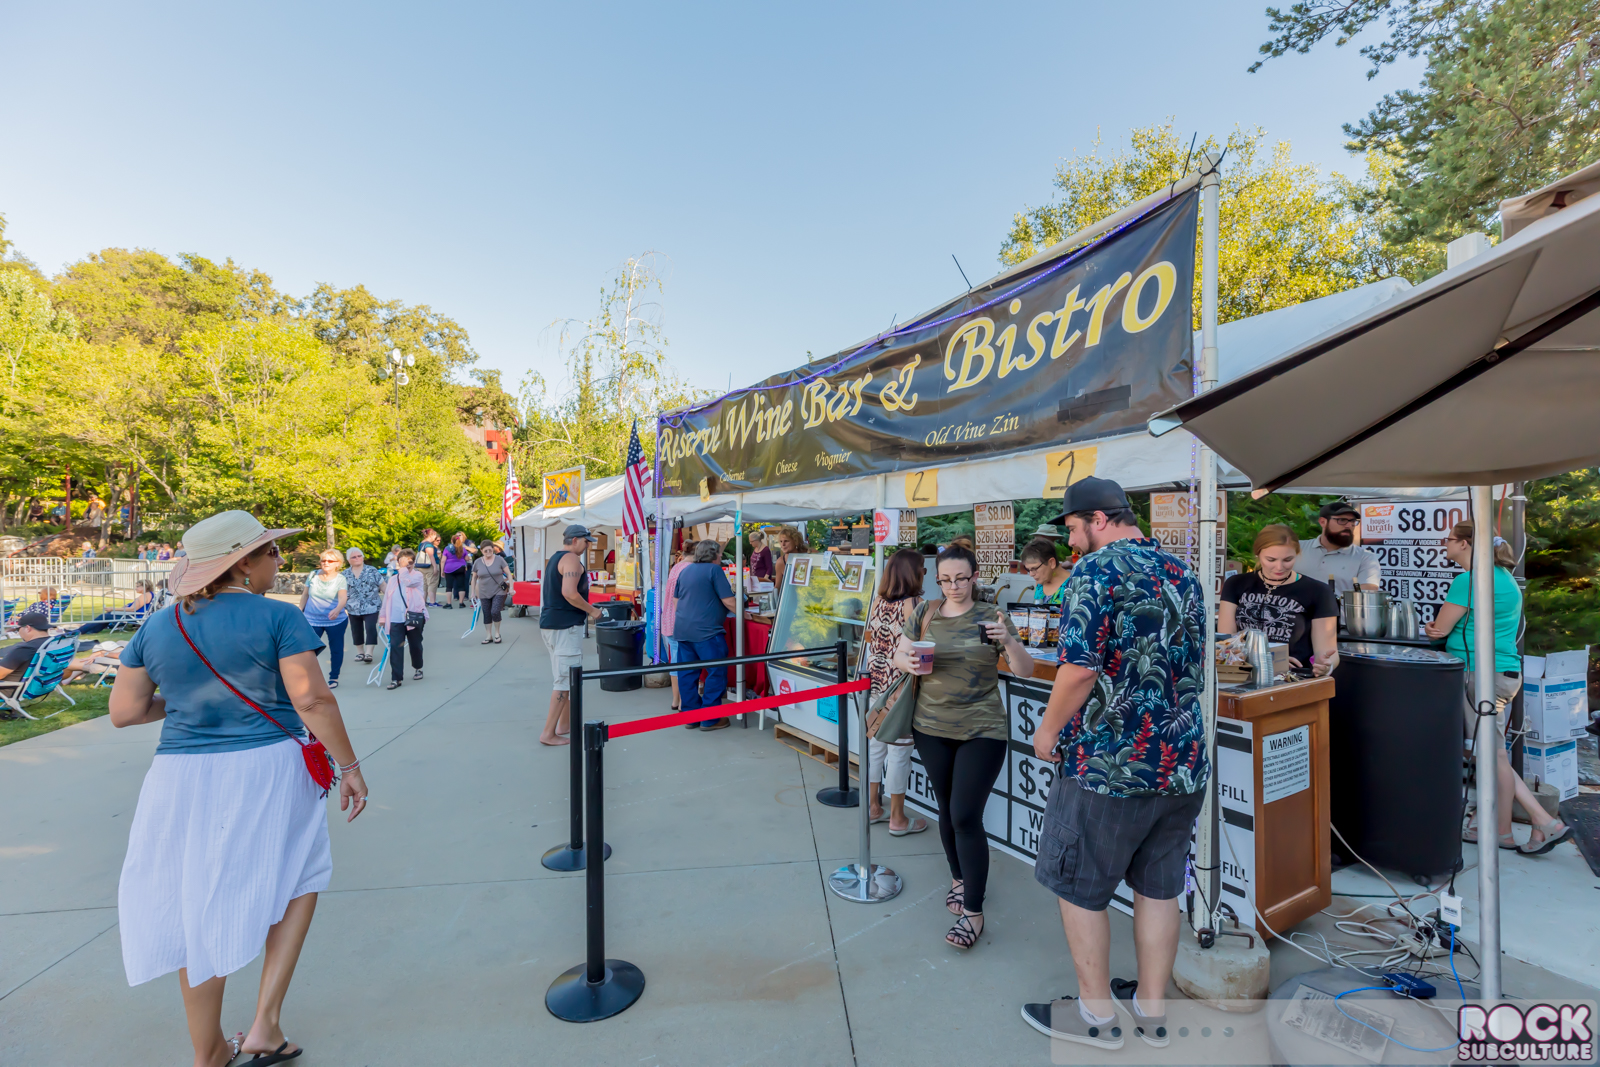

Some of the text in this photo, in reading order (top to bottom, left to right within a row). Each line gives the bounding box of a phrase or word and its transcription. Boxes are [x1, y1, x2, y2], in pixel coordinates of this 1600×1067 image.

[726, 393, 793, 450] Wine
[801, 372, 873, 430] Bar
[879, 353, 921, 412] &
[944, 261, 1177, 393] Bistro
[925, 413, 1019, 447] Old Vine Zin
[776, 459, 798, 476] Cheese
[815, 449, 852, 471] Viognier
[912, 471, 930, 502] 2
[988, 505, 1011, 521] $8.00
[1398, 508, 1463, 533] $8.00
[977, 530, 990, 544] $26
[994, 530, 1009, 544] $23
[977, 550, 990, 563] $36
[994, 550, 1009, 563] $33
[1366, 546, 1399, 567] 26
[1413, 547, 1447, 569] $23
[1269, 732, 1303, 751] WARNING
[1220, 860, 1249, 883] FILL
